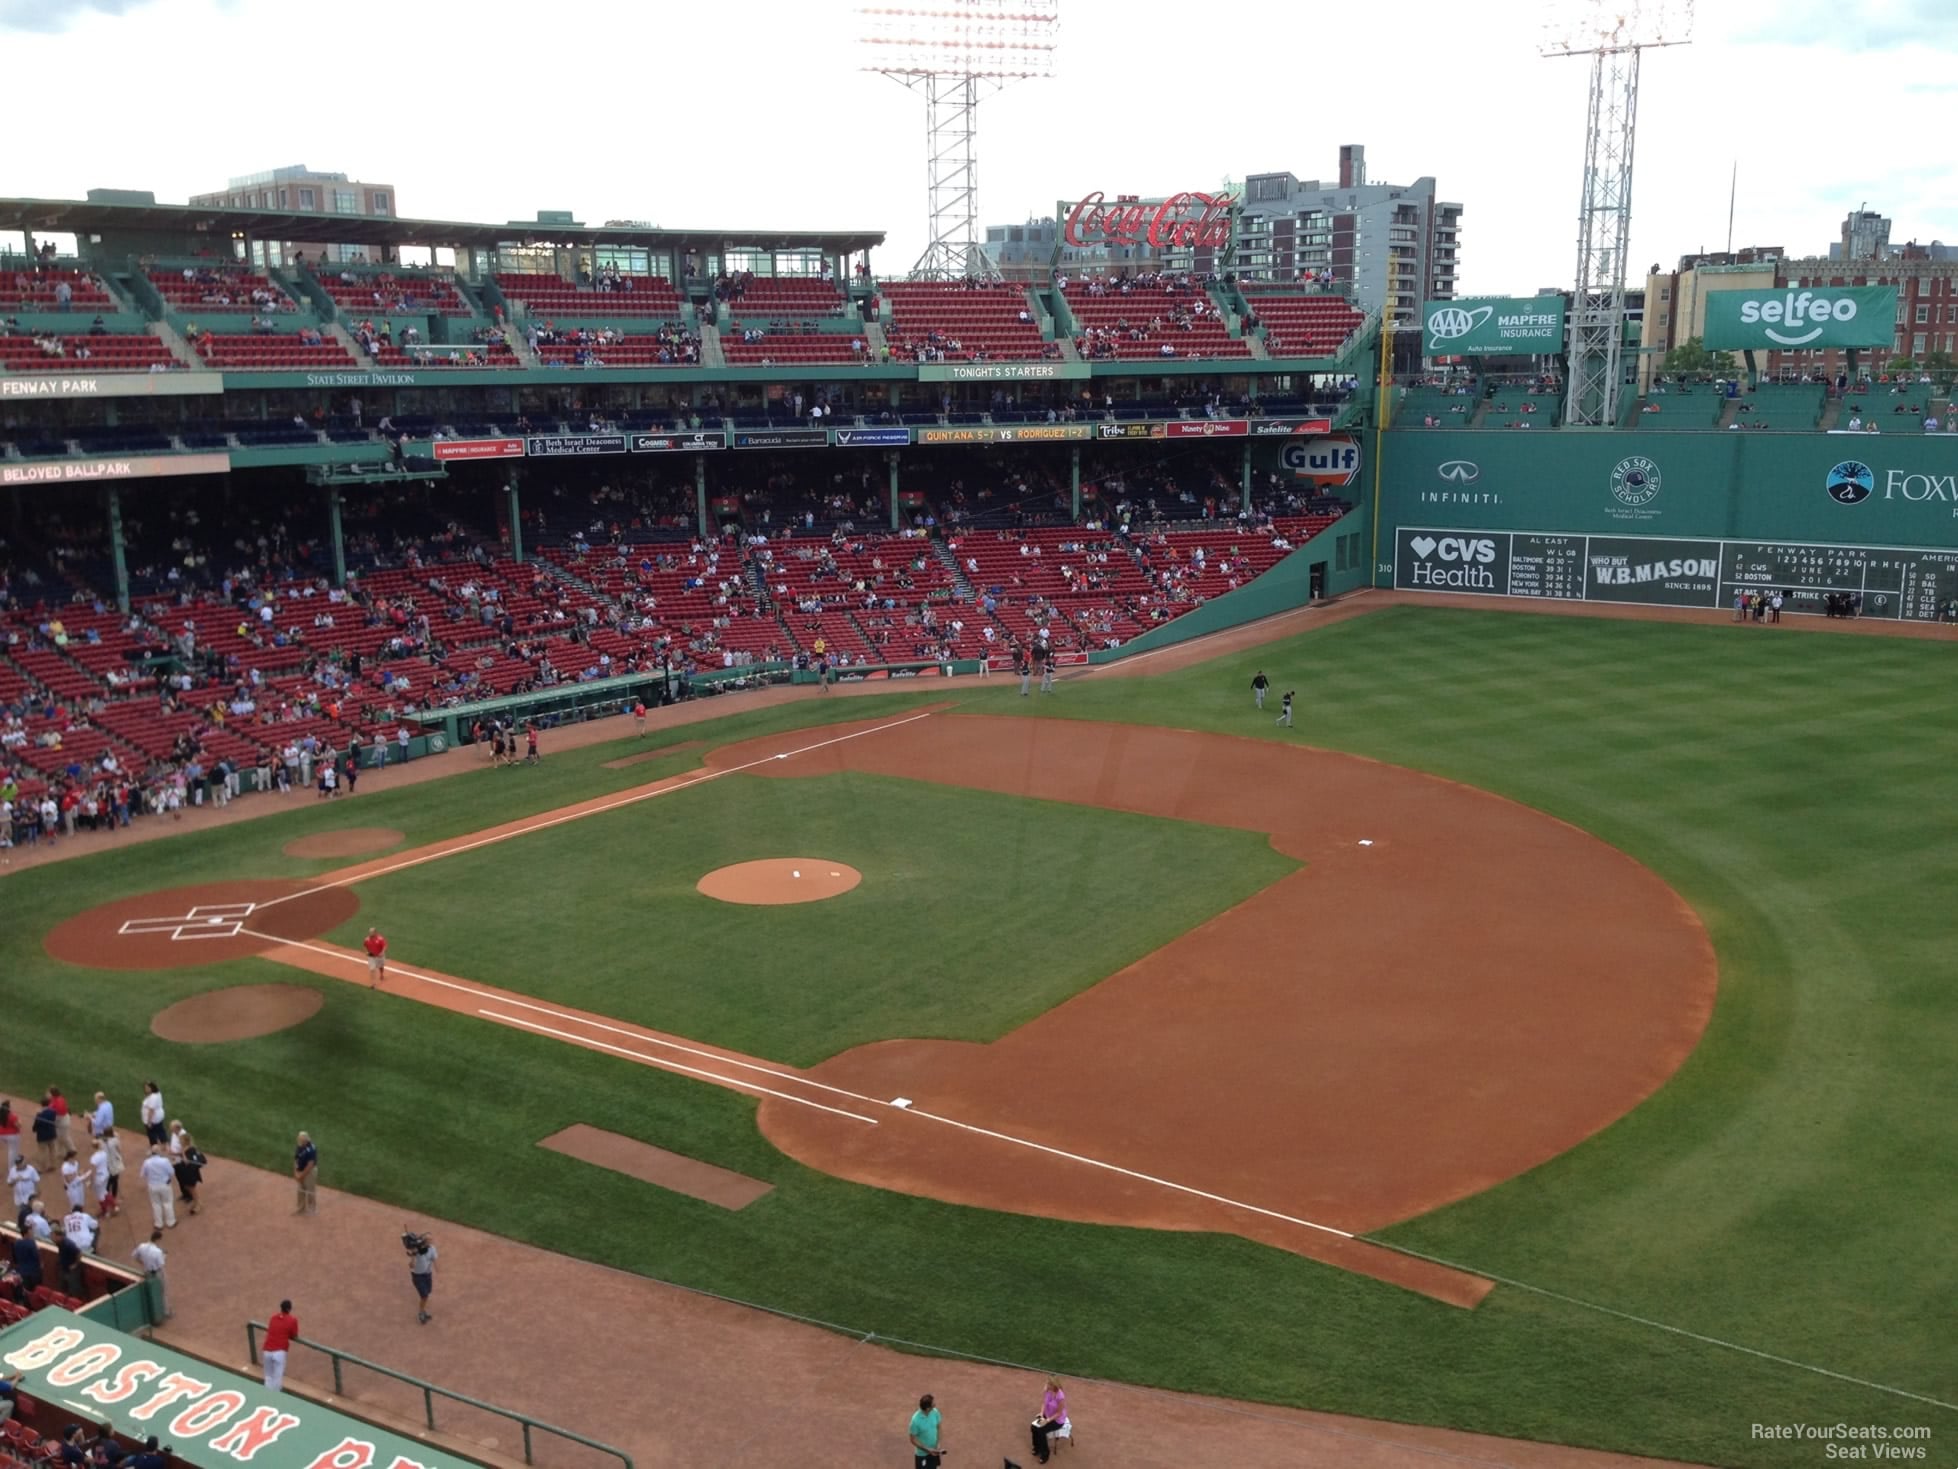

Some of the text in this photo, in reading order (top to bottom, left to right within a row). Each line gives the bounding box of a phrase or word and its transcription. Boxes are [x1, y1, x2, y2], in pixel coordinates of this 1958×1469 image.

[1433, 310, 1468, 336] AAA
[1498, 314, 1557, 325] MAPFRE
[1501, 328, 1552, 338] INSURANCE
[954, 367, 1054, 377] TONIGHT'S STARTERS
[308, 373, 414, 385] STATE STREET PAVILION
[3, 380, 97, 394] FENWAY PARK
[1100, 424, 1125, 437] Tribe
[1215, 424, 1230, 432] Nine
[1257, 426, 1292, 434] Safelite
[927, 431, 974, 440] QUINTANA
[1001, 430, 1012, 439] VS
[1018, 429, 1065, 438] RODRIGUEZ
[1285, 446, 1355, 469] Gulf
[1614, 461, 1630, 479] RED
[1633, 458, 1653, 471] SOX
[4, 463, 130, 481] BELOVED BALLPARK
[1615, 477, 1659, 503] SCHOLARS
[1422, 492, 1498, 504] INFINITI
[1438, 537, 1495, 563] CVS
[1758, 546, 1867, 558] FENWAY PARK
[1513, 556, 1544, 564] BALTIMORE
[1591, 557, 1628, 566] WHO BUT
[1792, 556, 1798, 564] 3
[1379, 564, 1392, 573] 310
[1792, 566, 1822, 574] JUNE
[1412, 562, 1494, 588] Health
[1512, 572, 1540, 580] TORONTO
[1745, 573, 1772, 581] BOSTON
[1792, 591, 1819, 600] STRIKE
[69, 1221, 81, 1232] 16
[4, 1326, 300, 1461] BOSTON
